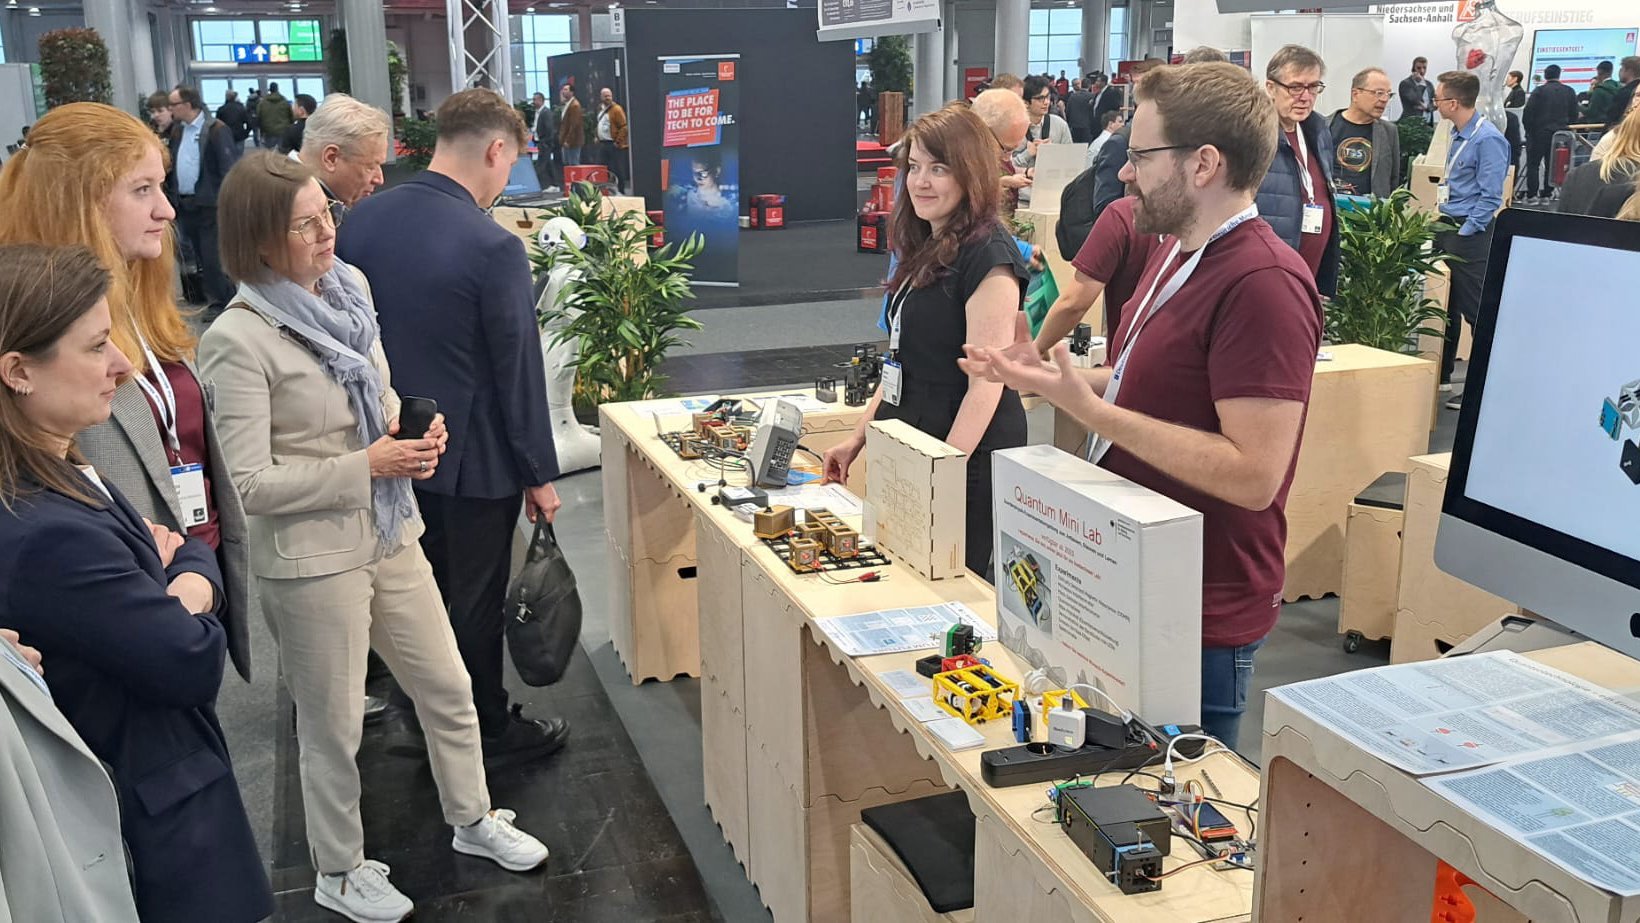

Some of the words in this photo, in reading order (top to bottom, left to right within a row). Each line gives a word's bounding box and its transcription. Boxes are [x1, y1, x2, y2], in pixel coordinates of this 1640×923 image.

[1377, 4, 1437, 14] Niedersachsen
[1438, 3, 1454, 13] und
[1388, 14, 1453, 24] Sachsen-Anhalt
[1506, 9, 1594, 24] ERUFSEINSTIEG
[667, 97, 685, 109] THE
[686, 95, 714, 107] PLACE
[667, 110, 679, 119] TO
[681, 108, 692, 118] BE
[694, 106, 713, 117] FOR
[667, 120, 688, 130] TECH
[690, 118, 703, 128] TO
[704, 114, 736, 126] COME.
[1014, 485, 1056, 521] Quantum
[1060, 508, 1079, 534] Mini
[1082, 520, 1102, 545] Lab
